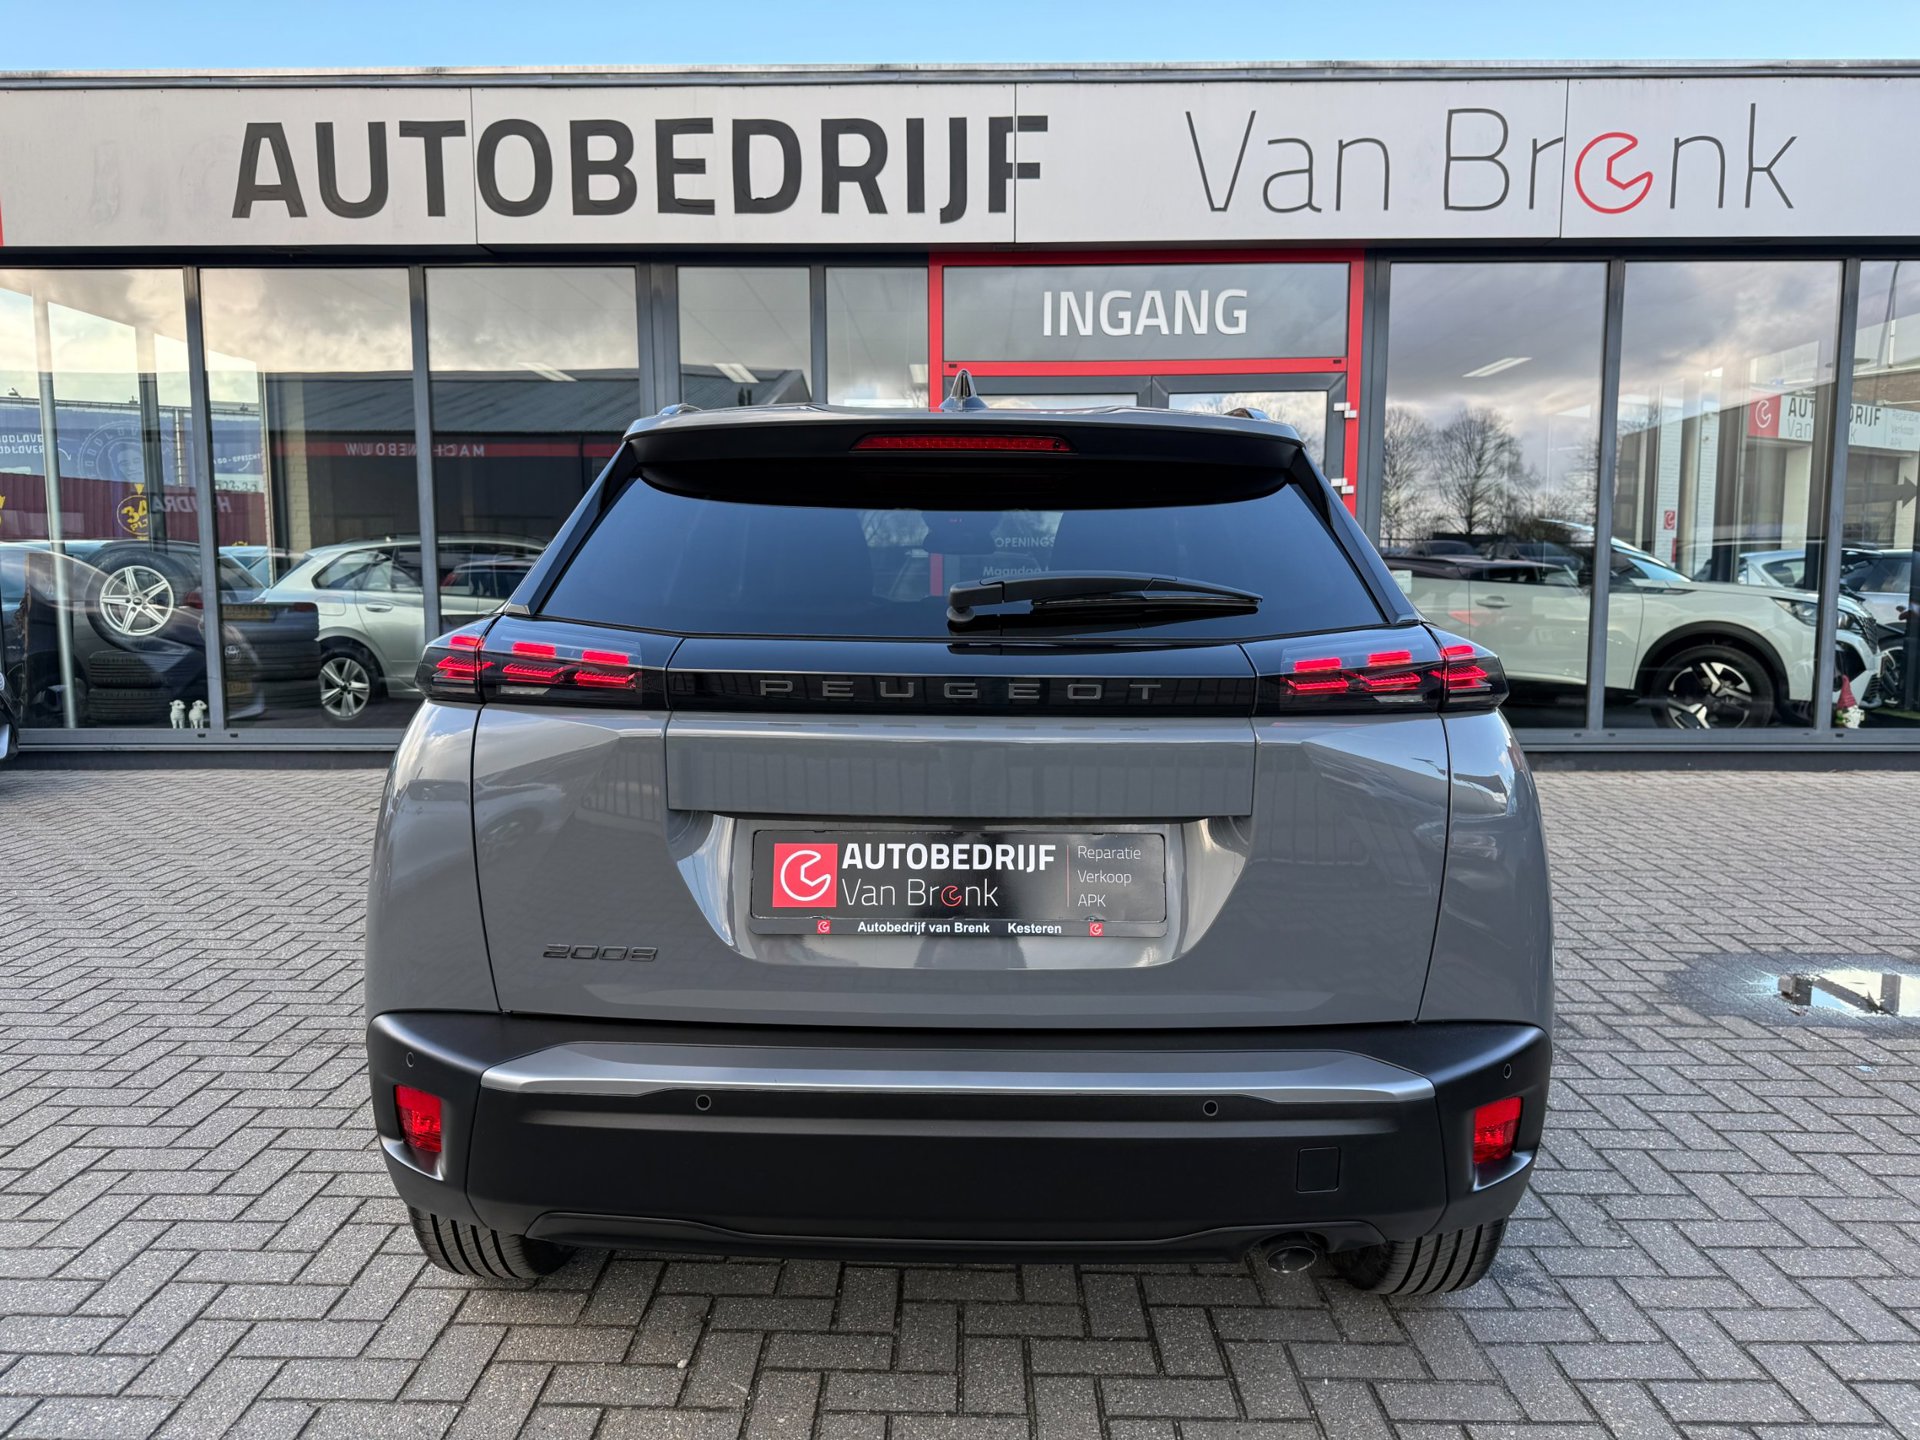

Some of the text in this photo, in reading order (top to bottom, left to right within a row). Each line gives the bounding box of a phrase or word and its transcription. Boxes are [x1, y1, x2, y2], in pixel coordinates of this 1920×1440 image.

[1186, 102, 1798, 214] Van Brenk
[232, 115, 1048, 224] AUTOBEDRIJF
[1043, 289, 1248, 336] INGANG
[760, 680, 1161, 700] PEUGEOT
[842, 843, 1056, 872] AUTOBEDRIJF
[1077, 845, 1141, 861] Reparatie
[1077, 869, 1132, 887] Verkoop
[842, 878, 998, 907] Van Brenk
[1077, 894, 1106, 907] APK
[857, 921, 1062, 935] Autobedrijf van Brenk Kesteren
[543, 943, 659, 962] 2008
